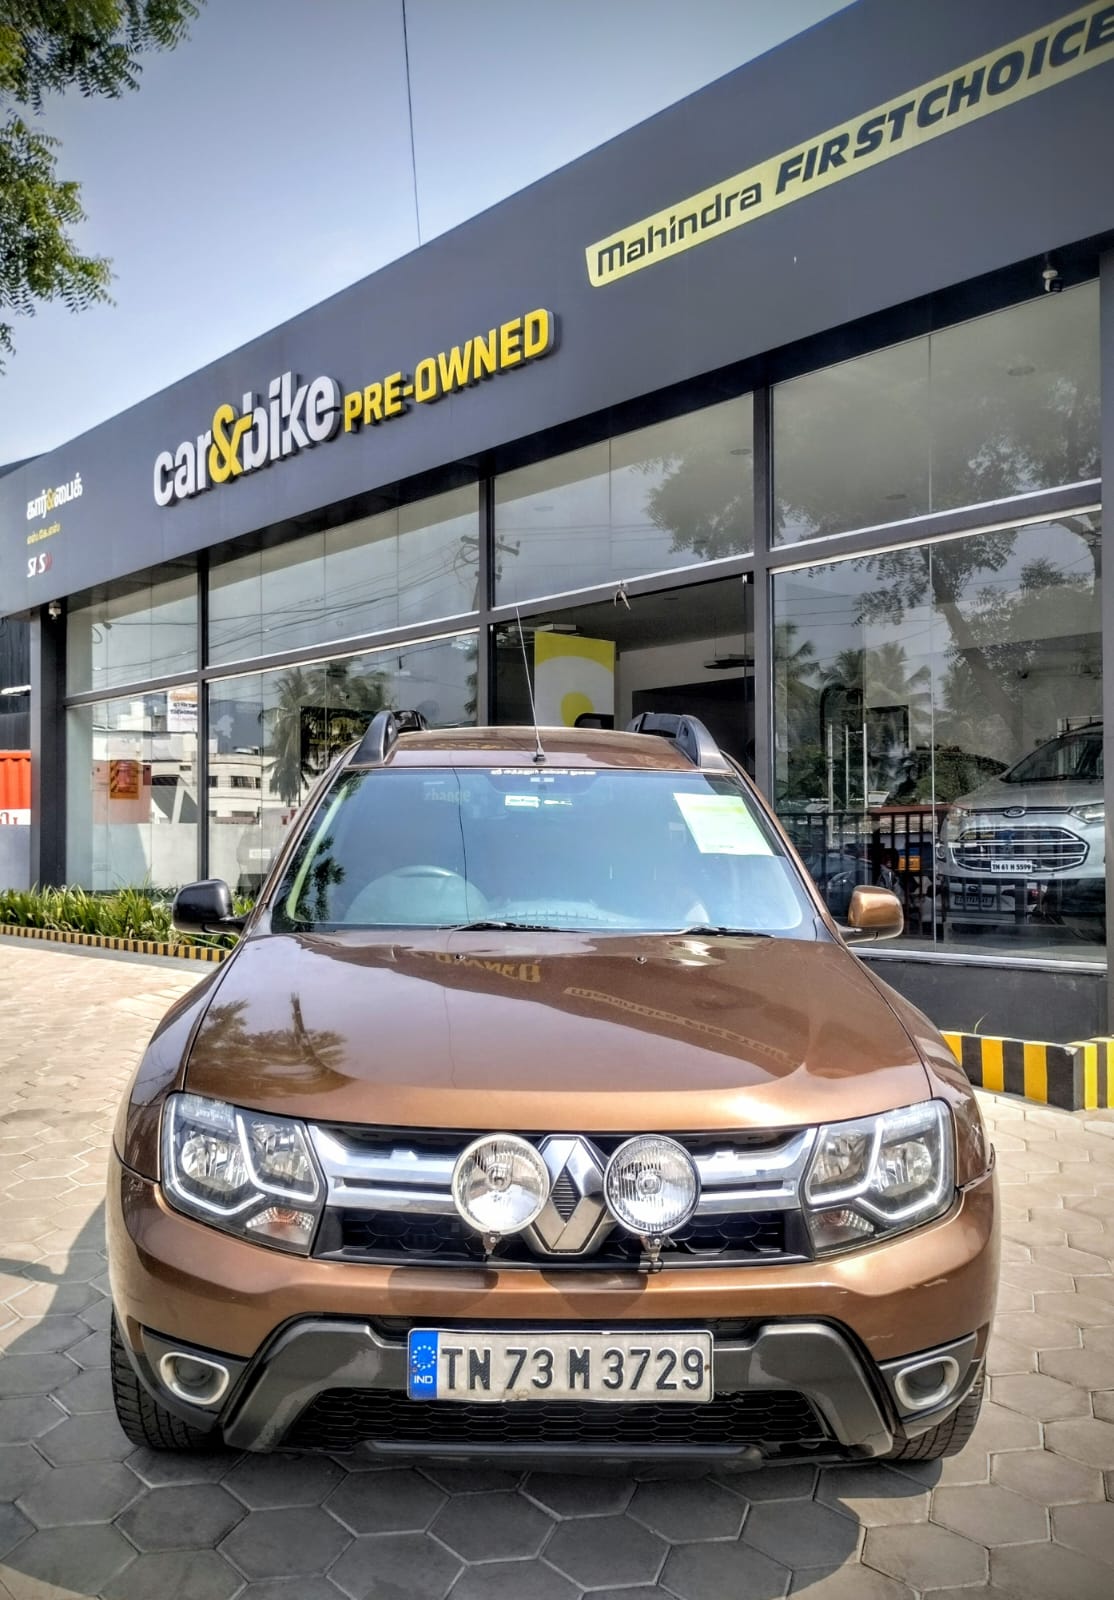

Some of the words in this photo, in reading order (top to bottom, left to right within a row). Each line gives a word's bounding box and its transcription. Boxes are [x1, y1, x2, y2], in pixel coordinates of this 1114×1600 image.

[597, 182, 762, 277] Mahindra
[775, 5, 1114, 196] FIRSTCHOICE
[153, 371, 342, 508] car&bike
[344, 308, 555, 433] PRE-OWNED
[414, 1375, 433, 1385] IND
[441, 1349, 492, 1391] TN
[506, 1349, 555, 1390] 73
[569, 1348, 591, 1390] M
[603, 1349, 705, 1391] 3729
